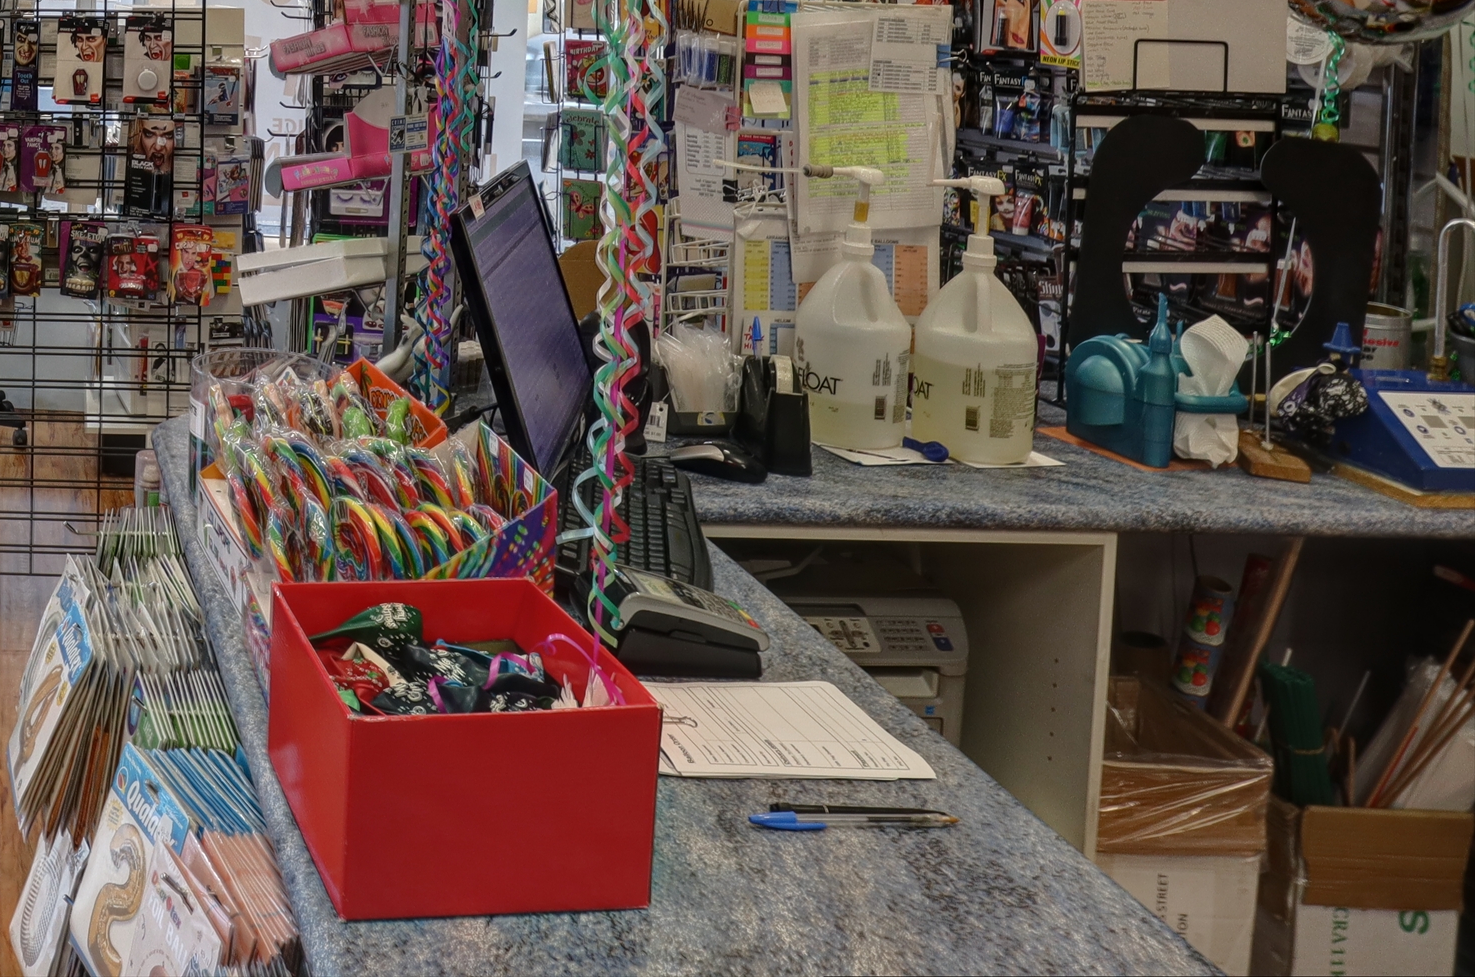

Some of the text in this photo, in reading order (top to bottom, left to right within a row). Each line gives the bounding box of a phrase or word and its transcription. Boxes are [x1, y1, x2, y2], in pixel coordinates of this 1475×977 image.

[1042, 56, 1056, 64] NEON
[1067, 58, 1080, 66] STICK
[1156, 873, 1170, 913] STREET
